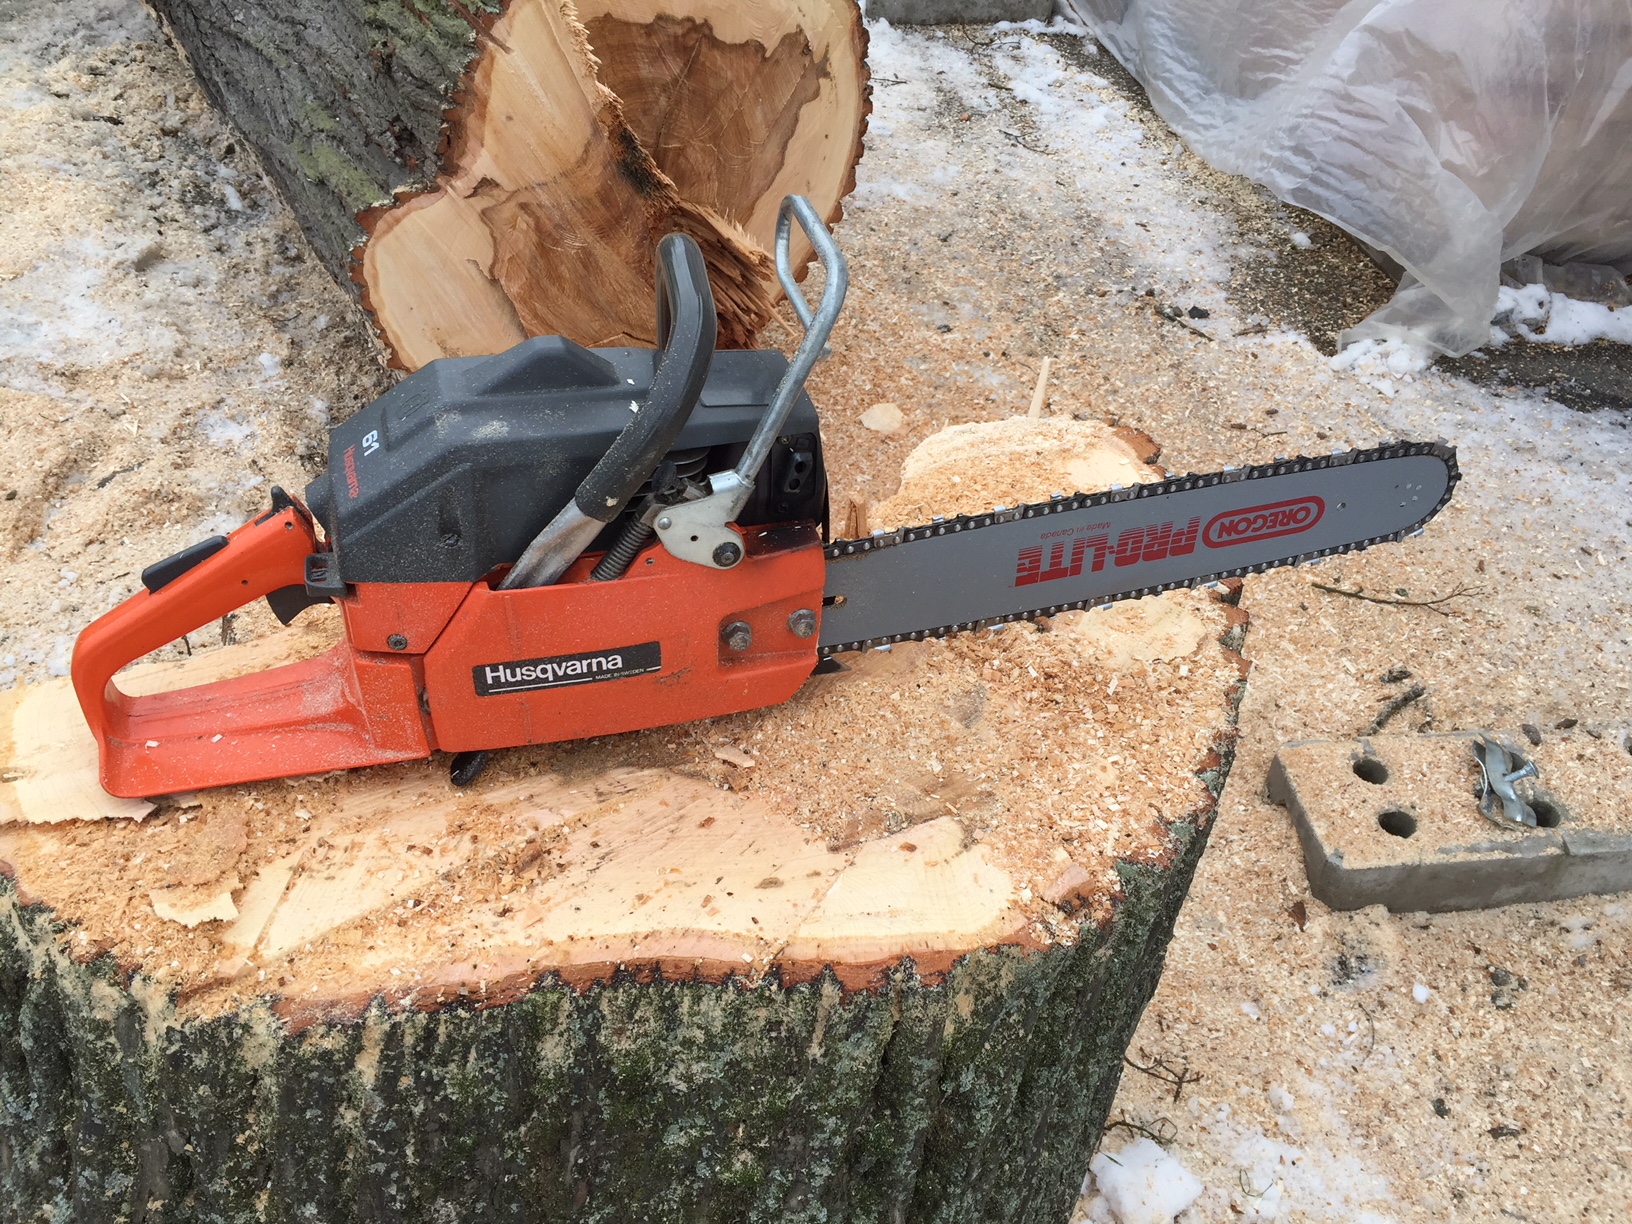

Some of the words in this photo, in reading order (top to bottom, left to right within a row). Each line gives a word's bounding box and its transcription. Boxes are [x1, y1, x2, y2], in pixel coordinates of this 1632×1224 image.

[362, 430, 380, 456] 61
[1040, 528, 1074, 540] Canada
[1086, 521, 1111, 532] Made
[1217, 506, 1311, 539] OREGON
[1015, 516, 1202, 587] PRO-LITE
[485, 654, 623, 685] Husqvarna
[620, 668, 645, 676] SWEDEN
